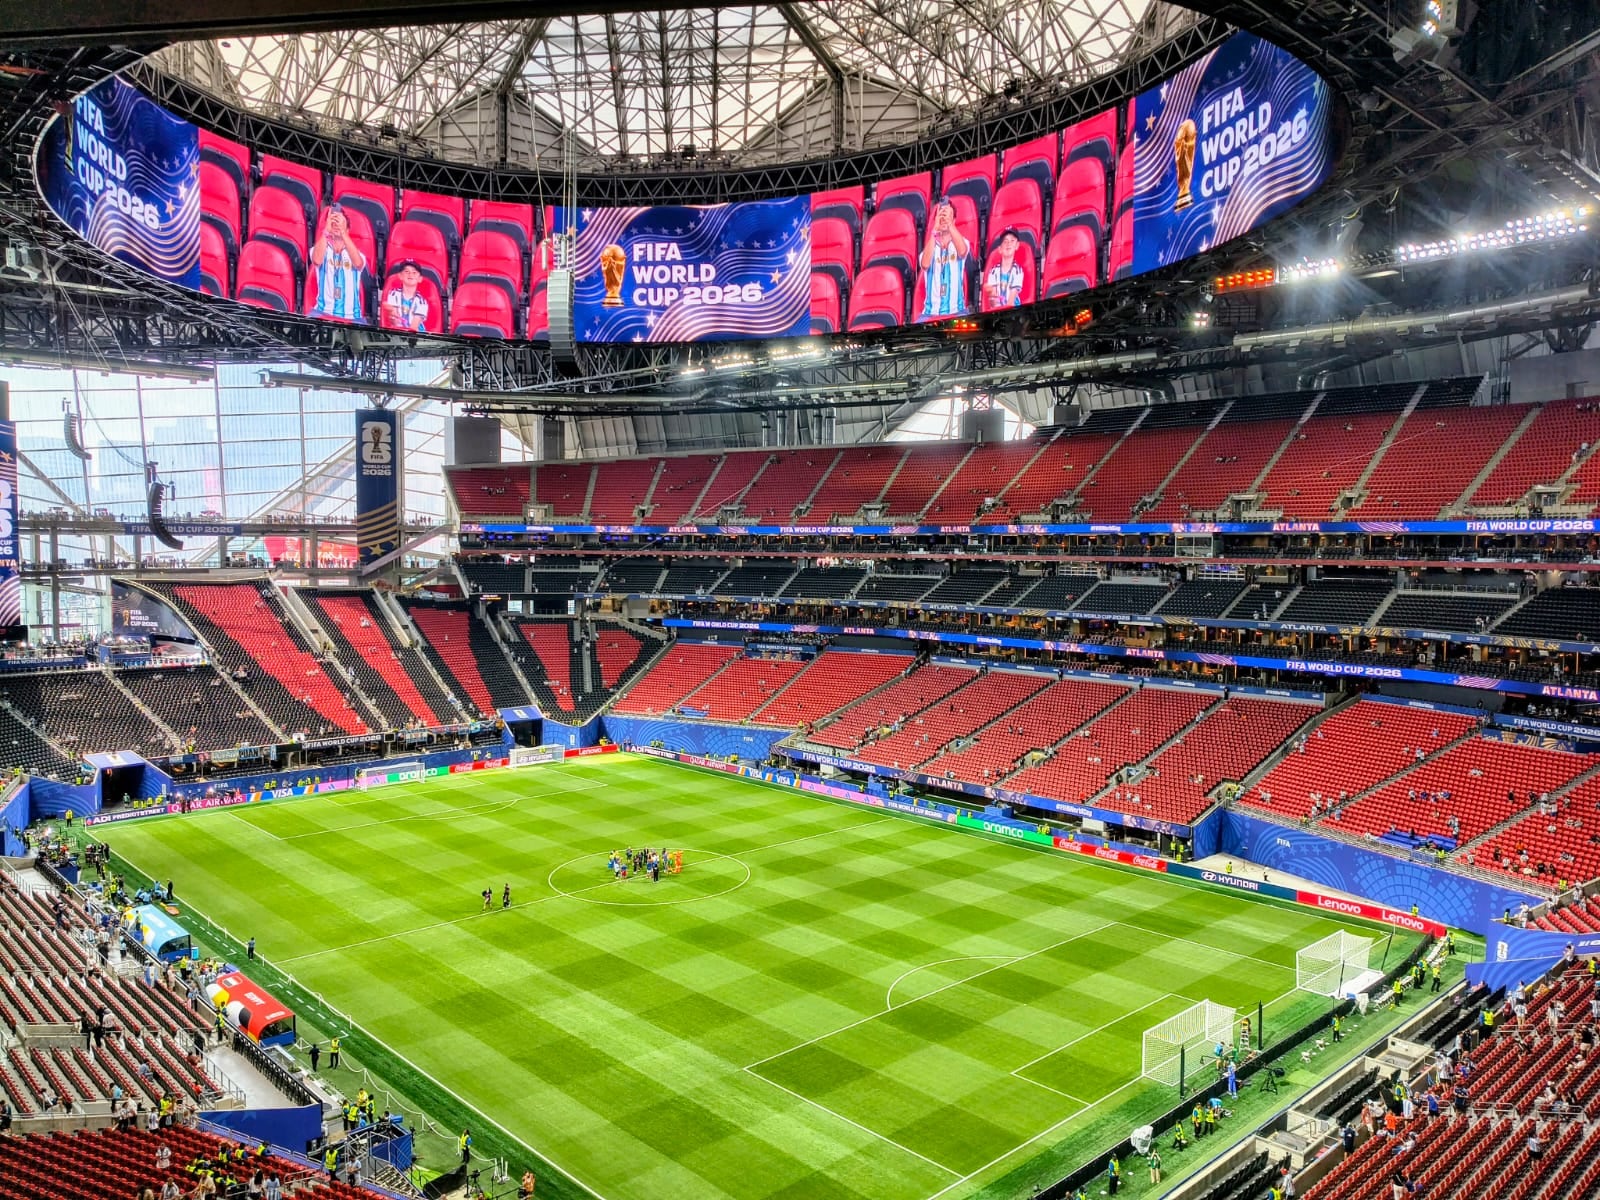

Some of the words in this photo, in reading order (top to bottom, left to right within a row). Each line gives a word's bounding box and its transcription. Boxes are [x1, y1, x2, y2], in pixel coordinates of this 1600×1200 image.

[77, 95, 104, 137] FIFA
[1202, 86, 1244, 134] FIFA
[1202, 102, 1272, 165] WORLD
[77, 120, 126, 180] WORLD
[1201, 158, 1240, 198] CUP
[1242, 111, 1308, 176] 2026
[78, 157, 103, 195] CUP
[105, 179, 159, 229] 2026
[632, 242, 682, 261] FIFA
[632, 264, 715, 283] WORLD
[633, 287, 678, 306] CUP
[682, 284, 762, 304] 2026
[1273, 523, 1319, 531] ATLANTA
[1466, 522, 1488, 530] FIFA
[1490, 522, 1527, 530] WORLD
[1529, 522, 1551, 530] CUP
[1552, 520, 1594, 530] 2026
[844, 627, 875, 635] ATLANTA
[1280, 624, 1327, 632] ATLANTA
[1126, 648, 1164, 659] ATLANTA
[1286, 661, 1306, 670] FIFA
[1308, 662, 1342, 673] WORLD
[1344, 664, 1364, 674] CUP
[1365, 667, 1402, 677] 2026
[1542, 686, 1598, 700] ATLANTA
[1514, 718, 1530, 726] FIFA
[1530, 721, 1557, 730] WORLD
[1558, 724, 1573, 732] CUP
[1573, 727, 1600, 736] 2026
[689, 757, 706, 767] QATAR
[803, 752, 816, 761] FIFA
[816, 754, 839, 766] WORLD
[839, 758, 852, 768] CUP
[853, 763, 876, 774] 2026
[750, 768, 762, 779] VISA
[777, 776, 791, 785] VISA
[927, 777, 963, 792] ATLANTA
[273, 788, 294, 798] VISA
[171, 800, 202, 812] QAR
[899, 804, 914, 813] WORLD
[915, 807, 925, 815] CUP
[93, 816, 111, 825] ADI
[984, 822, 1024, 838] aramco
[1060, 838, 1082, 852] Coca-Cola
[1276, 838, 1291, 849] FIFA
[1095, 847, 1119, 860] Coca-Cola
[1133, 855, 1158, 869] Coca-Cola
[1218, 875, 1259, 891] HYUNDAI
[1318, 896, 1361, 915] Lenovo
[1382, 909, 1424, 931] Lenovo
